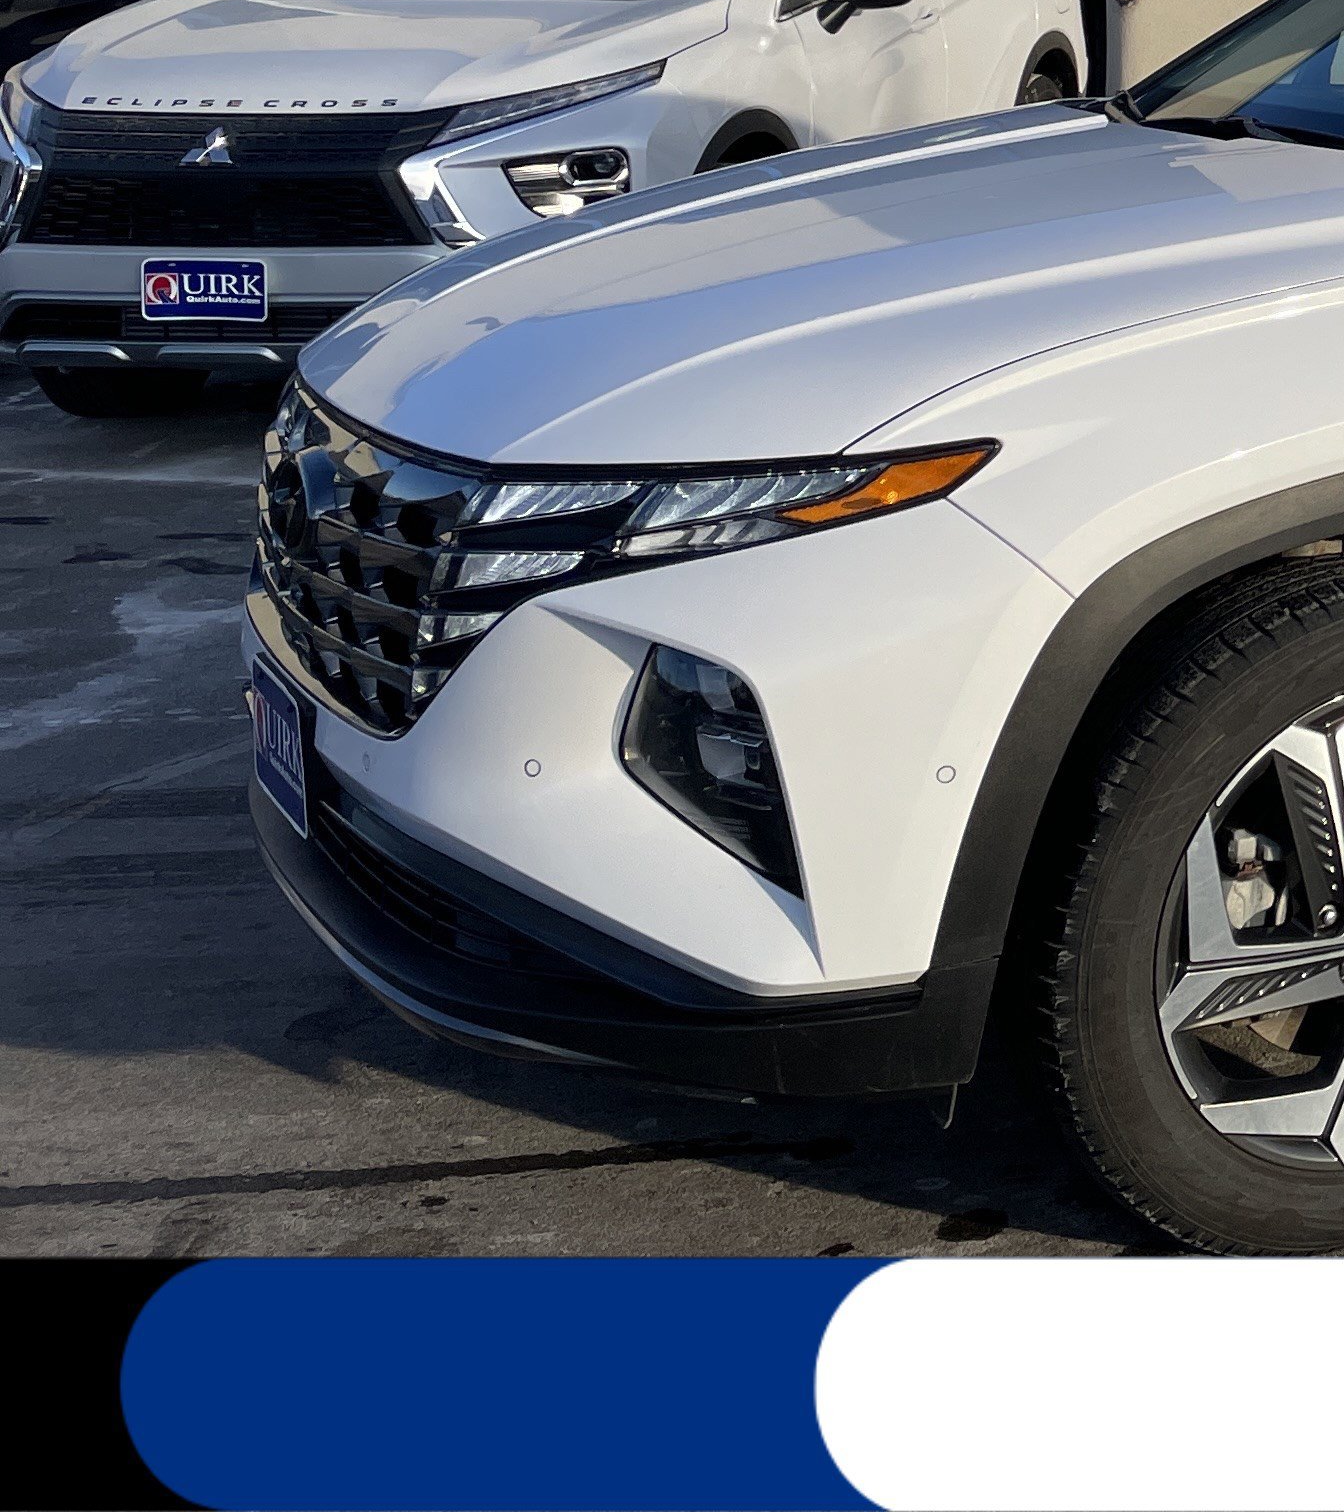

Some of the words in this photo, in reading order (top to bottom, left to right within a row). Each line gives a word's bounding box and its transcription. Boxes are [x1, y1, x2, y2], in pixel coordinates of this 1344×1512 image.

[81, 96, 244, 107] ECLIPSE
[263, 98, 399, 108] CROSS
[146, 273, 264, 305] QUIRK
[186, 295, 261, 304] QuirkAuto.com
